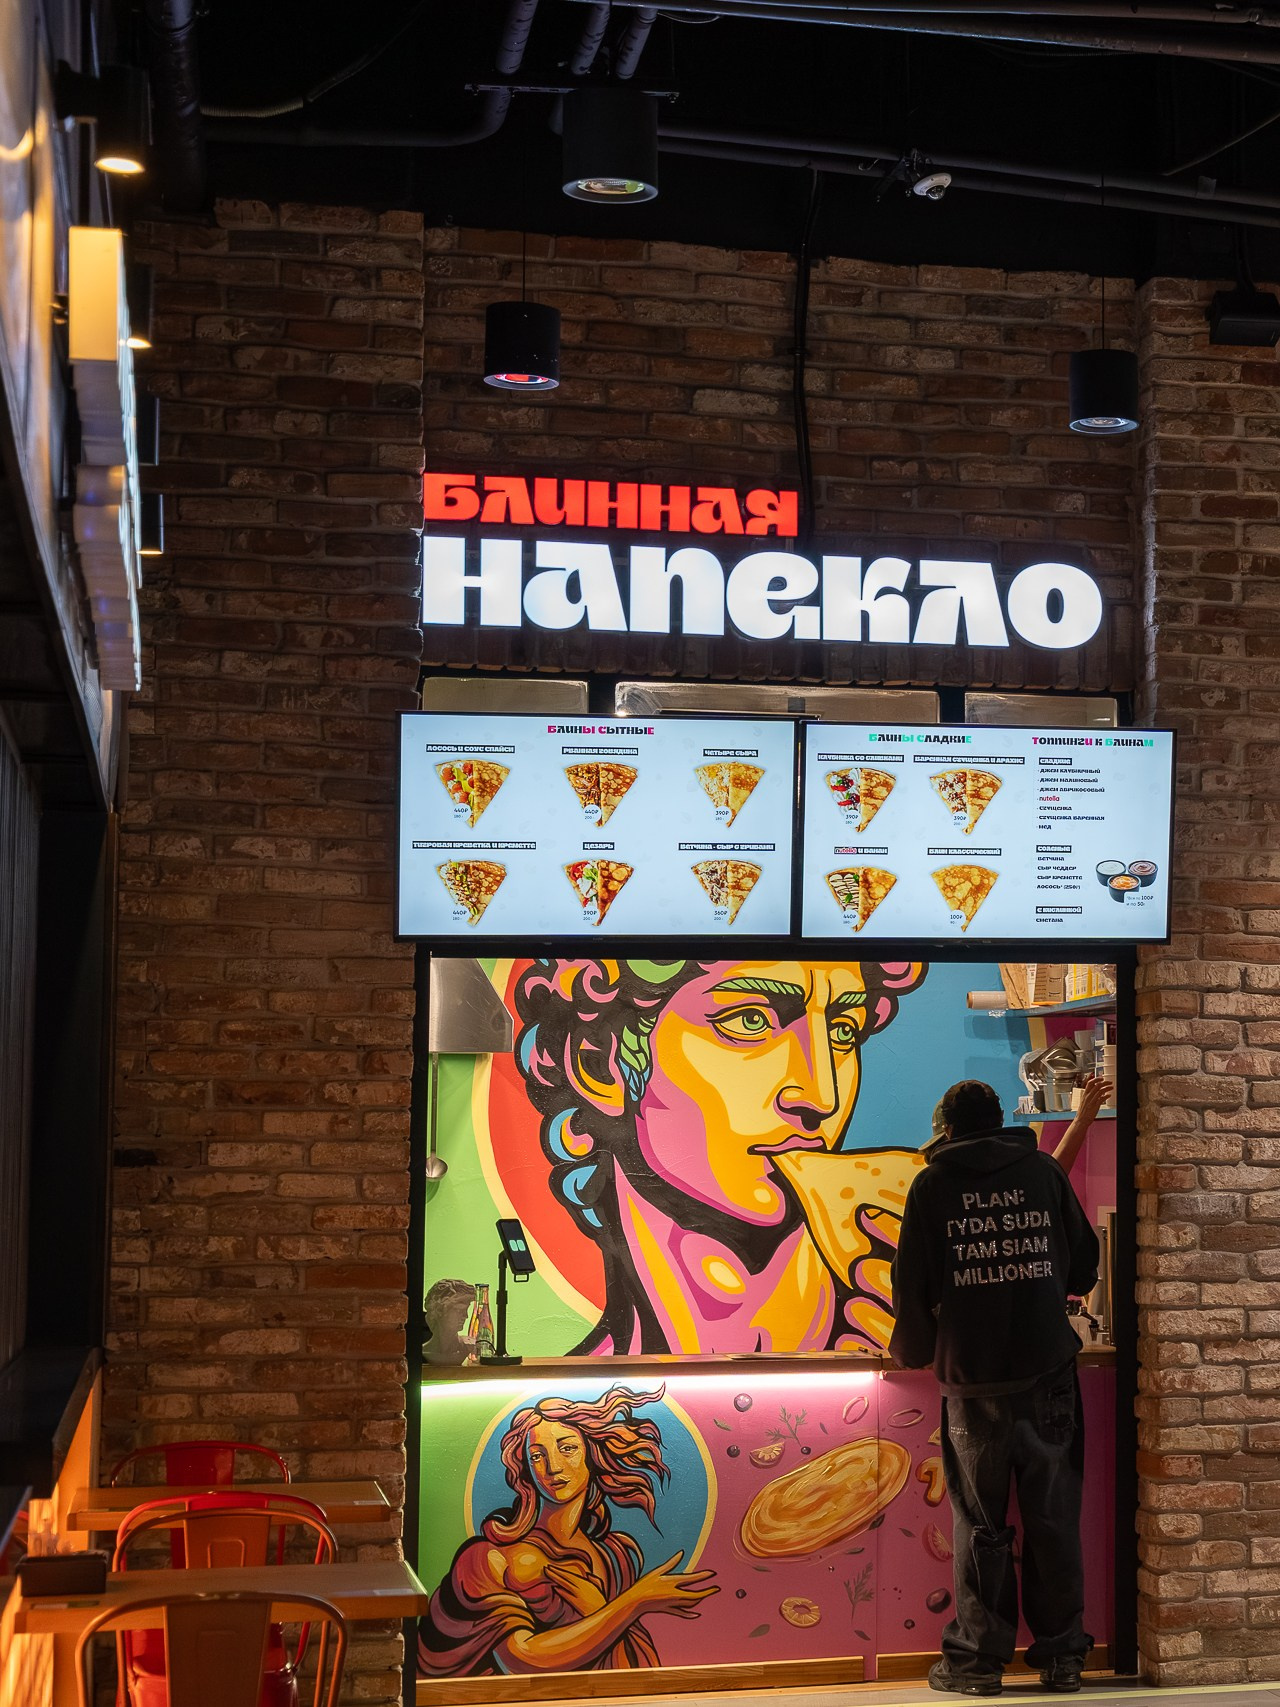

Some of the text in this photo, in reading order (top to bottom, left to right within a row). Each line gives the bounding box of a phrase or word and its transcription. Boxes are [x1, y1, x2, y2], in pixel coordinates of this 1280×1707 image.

[962, 1189, 1024, 1210] PLAN:
[1002, 1211, 1051, 1232] SUDA
[952, 1236, 1048, 1261] TAM SIAM
[953, 1260, 1052, 1286] MILLIONER
